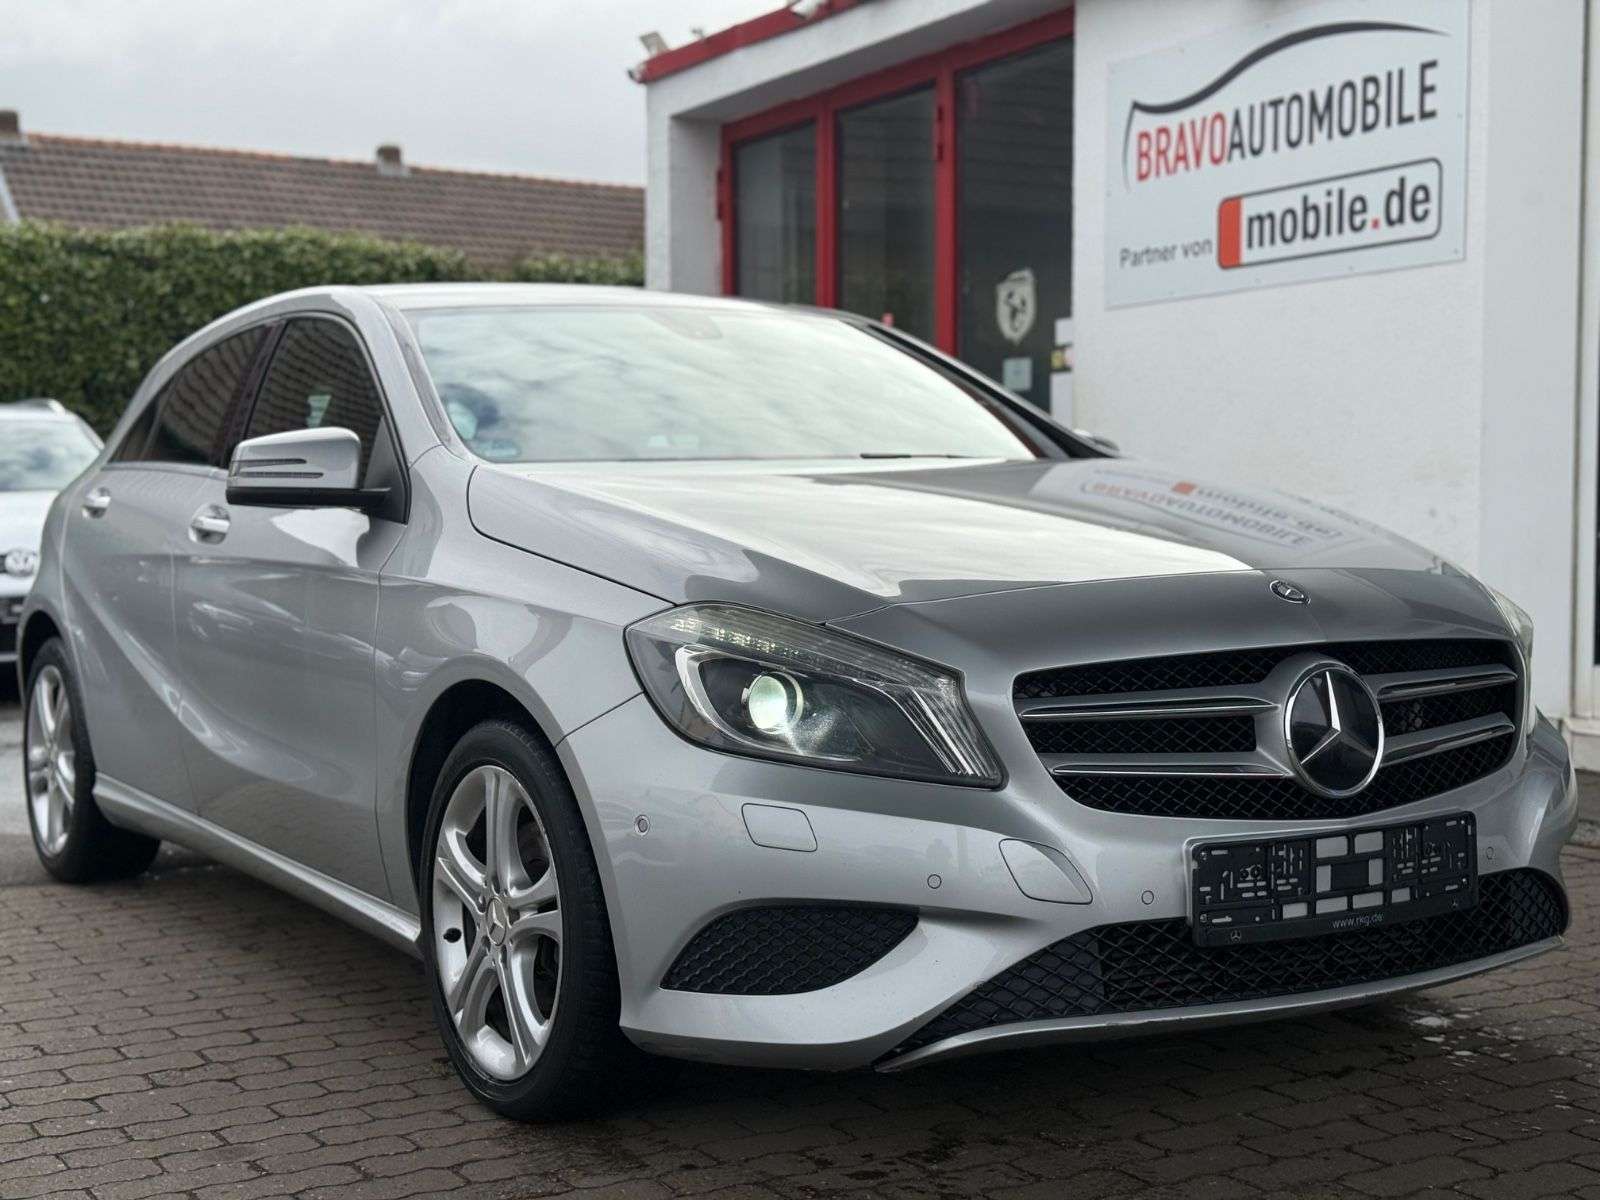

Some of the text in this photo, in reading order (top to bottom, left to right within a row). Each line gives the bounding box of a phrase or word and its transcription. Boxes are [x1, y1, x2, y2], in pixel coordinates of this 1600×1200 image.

[1135, 59, 1438, 183] BRAVOAUTOMOBILE
[1119, 177, 1431, 268] Partner von mobile.de
